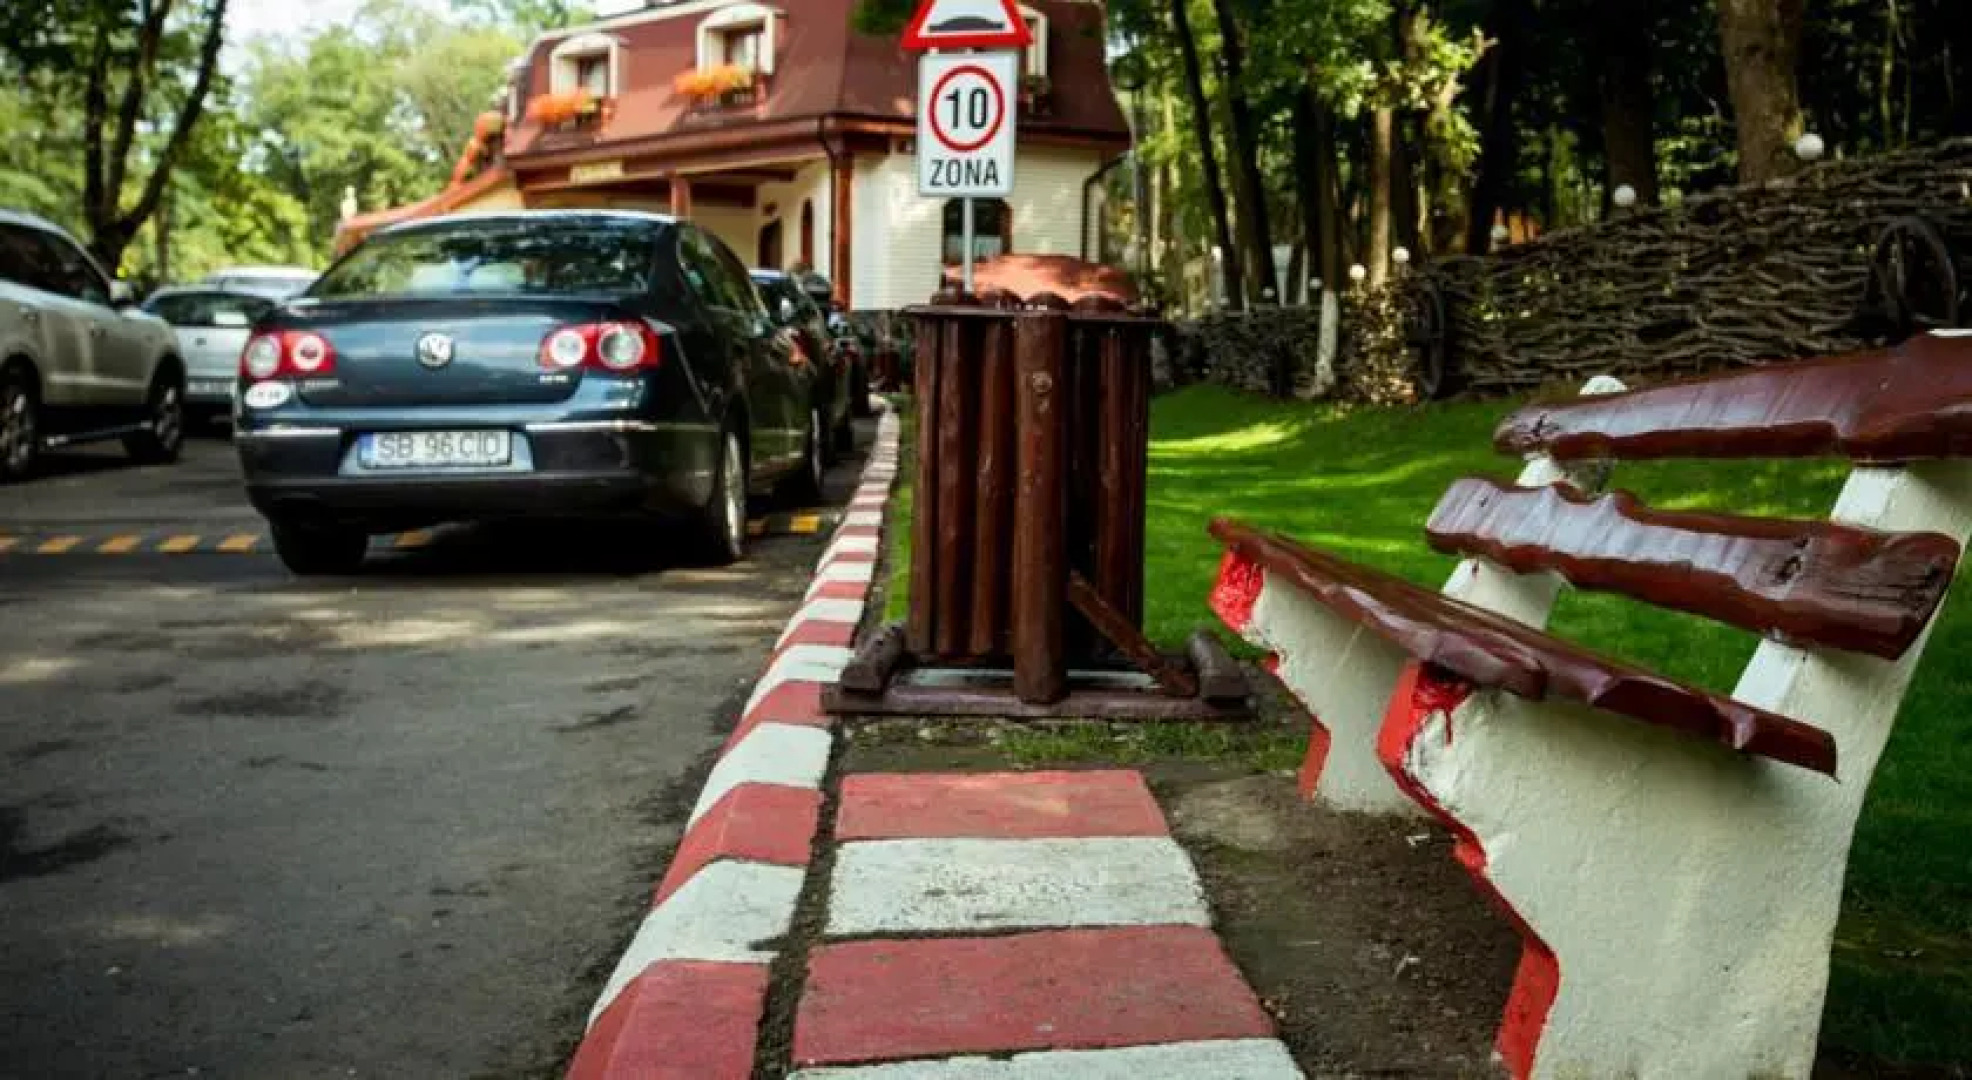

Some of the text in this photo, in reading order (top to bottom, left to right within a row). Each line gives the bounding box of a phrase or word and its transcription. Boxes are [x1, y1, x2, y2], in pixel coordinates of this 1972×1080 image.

[945, 88, 988, 129] 10
[929, 159, 999, 186] ZONA
[377, 432, 413, 459] SB
